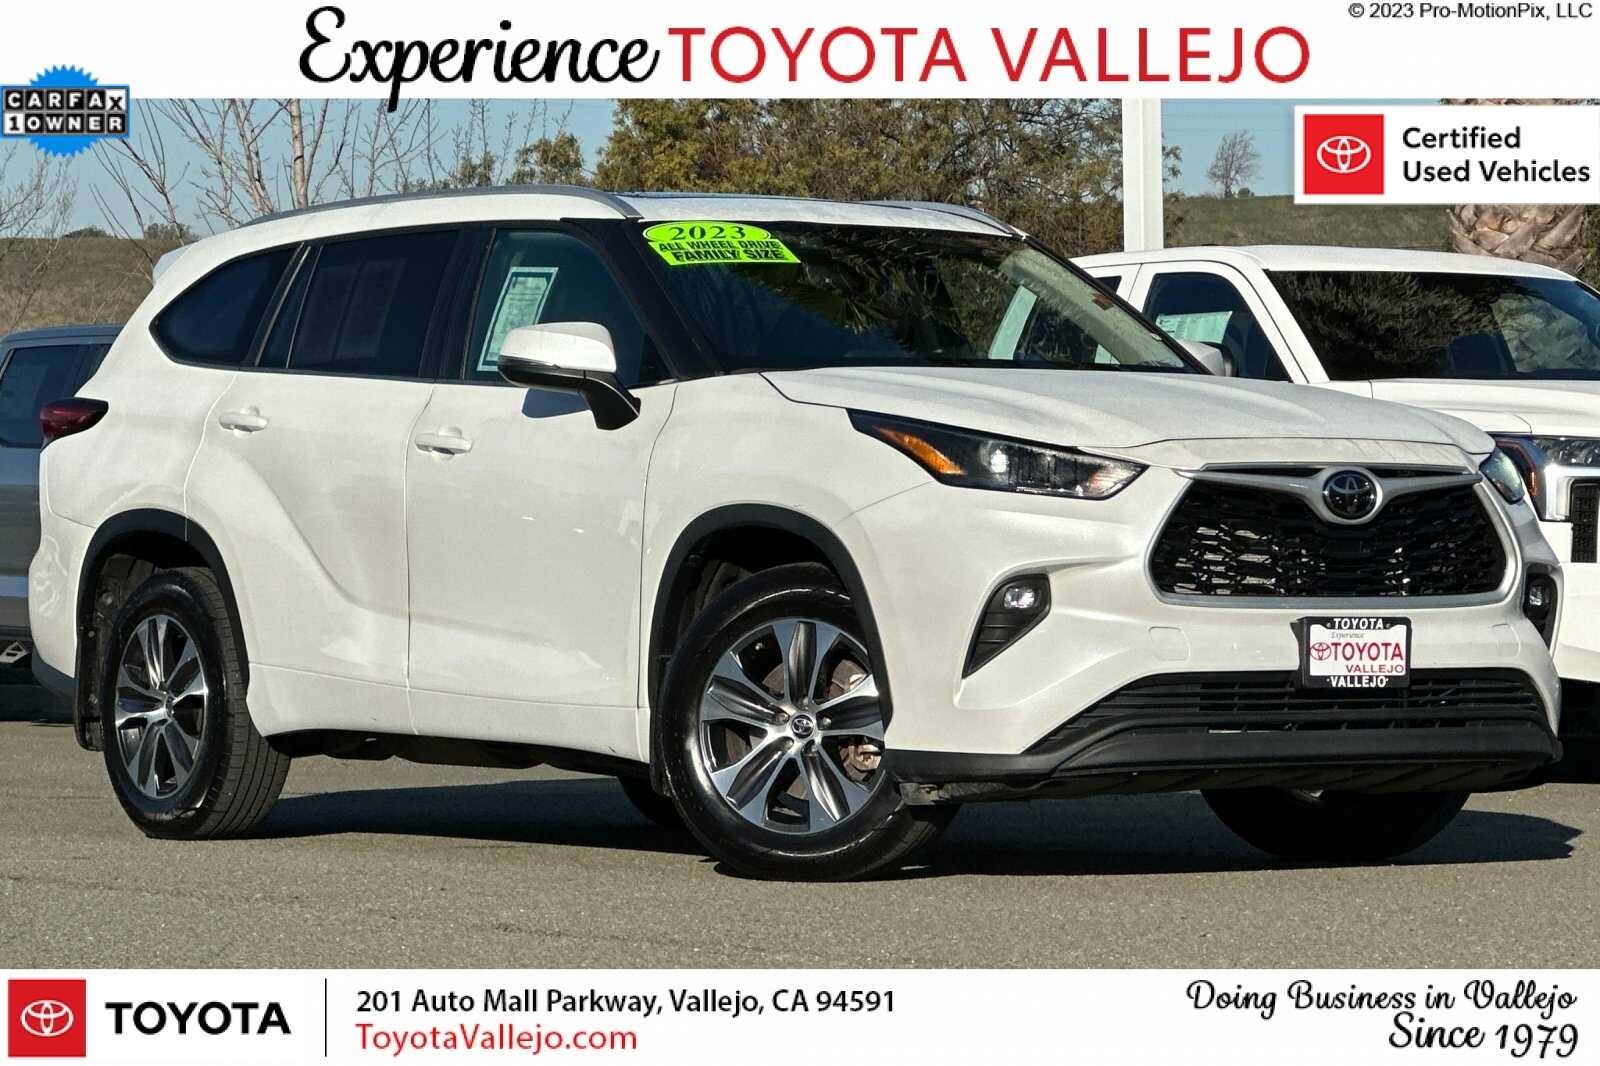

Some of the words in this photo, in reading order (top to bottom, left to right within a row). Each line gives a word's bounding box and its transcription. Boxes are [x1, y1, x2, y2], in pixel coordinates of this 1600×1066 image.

[669, 225, 746, 241] 2023
[659, 242, 684, 251] ALL
[686, 240, 735, 250] WHEEL
[738, 239, 782, 249] DRIVE
[672, 250, 740, 262] FAMILY
[746, 249, 785, 260] SIZE
[1333, 618, 1384, 630] TOYOTA
[1331, 642, 1404, 661] TOYOTA
[1346, 664, 1405, 673] VALLEJO
[1330, 676, 1387, 688] VALLEJO
